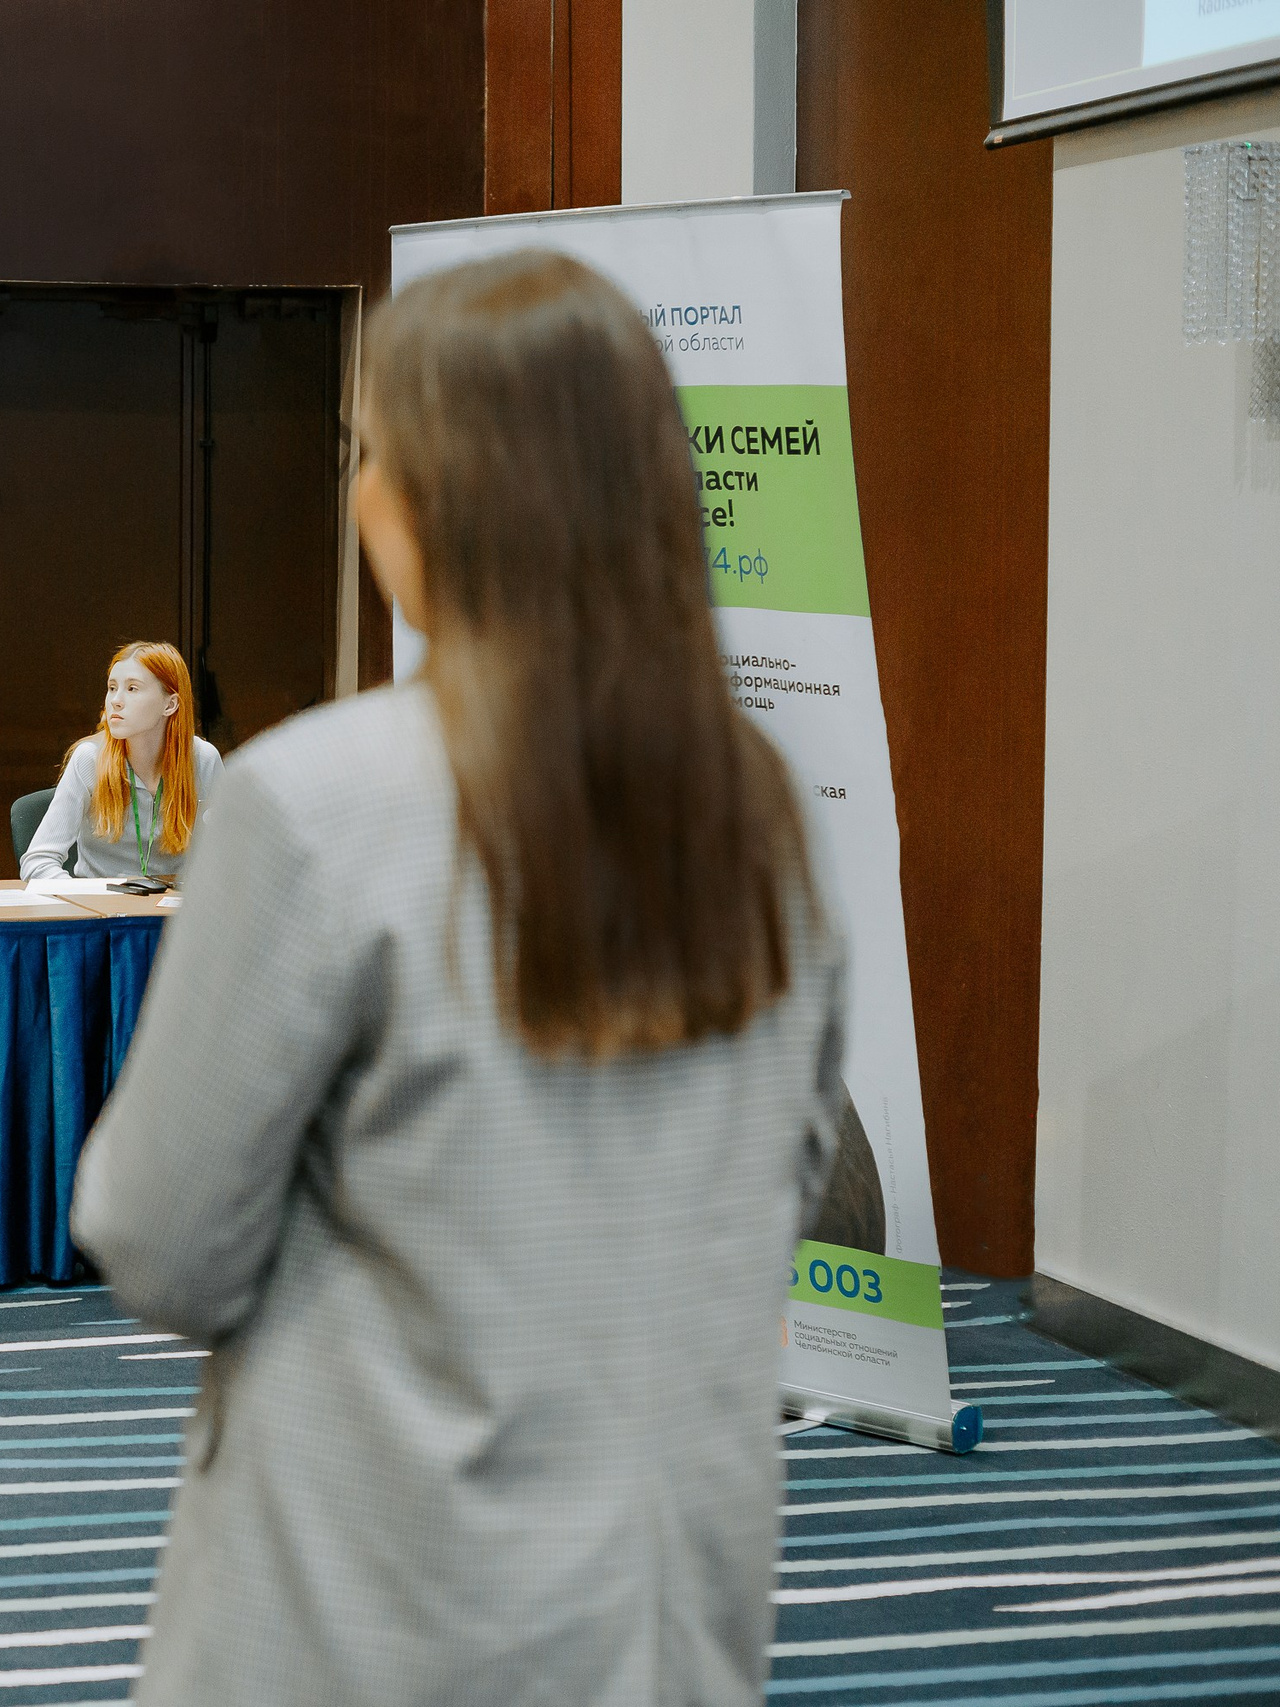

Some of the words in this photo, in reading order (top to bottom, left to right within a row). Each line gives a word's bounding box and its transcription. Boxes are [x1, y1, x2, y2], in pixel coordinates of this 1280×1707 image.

[671, 305, 742, 326] ПОРТАЛ
[678, 332, 745, 352] области
[731, 419, 821, 456] СЕМЕЙ
[730, 671, 841, 696] формационная
[809, 1259, 883, 1304] 003
[794, 1320, 857, 1341] Министерство
[795, 1332, 848, 1349] социальных
[849, 1343, 898, 1358] отношений
[795, 1340, 853, 1360] Челябинской
[855, 1353, 891, 1367] области
